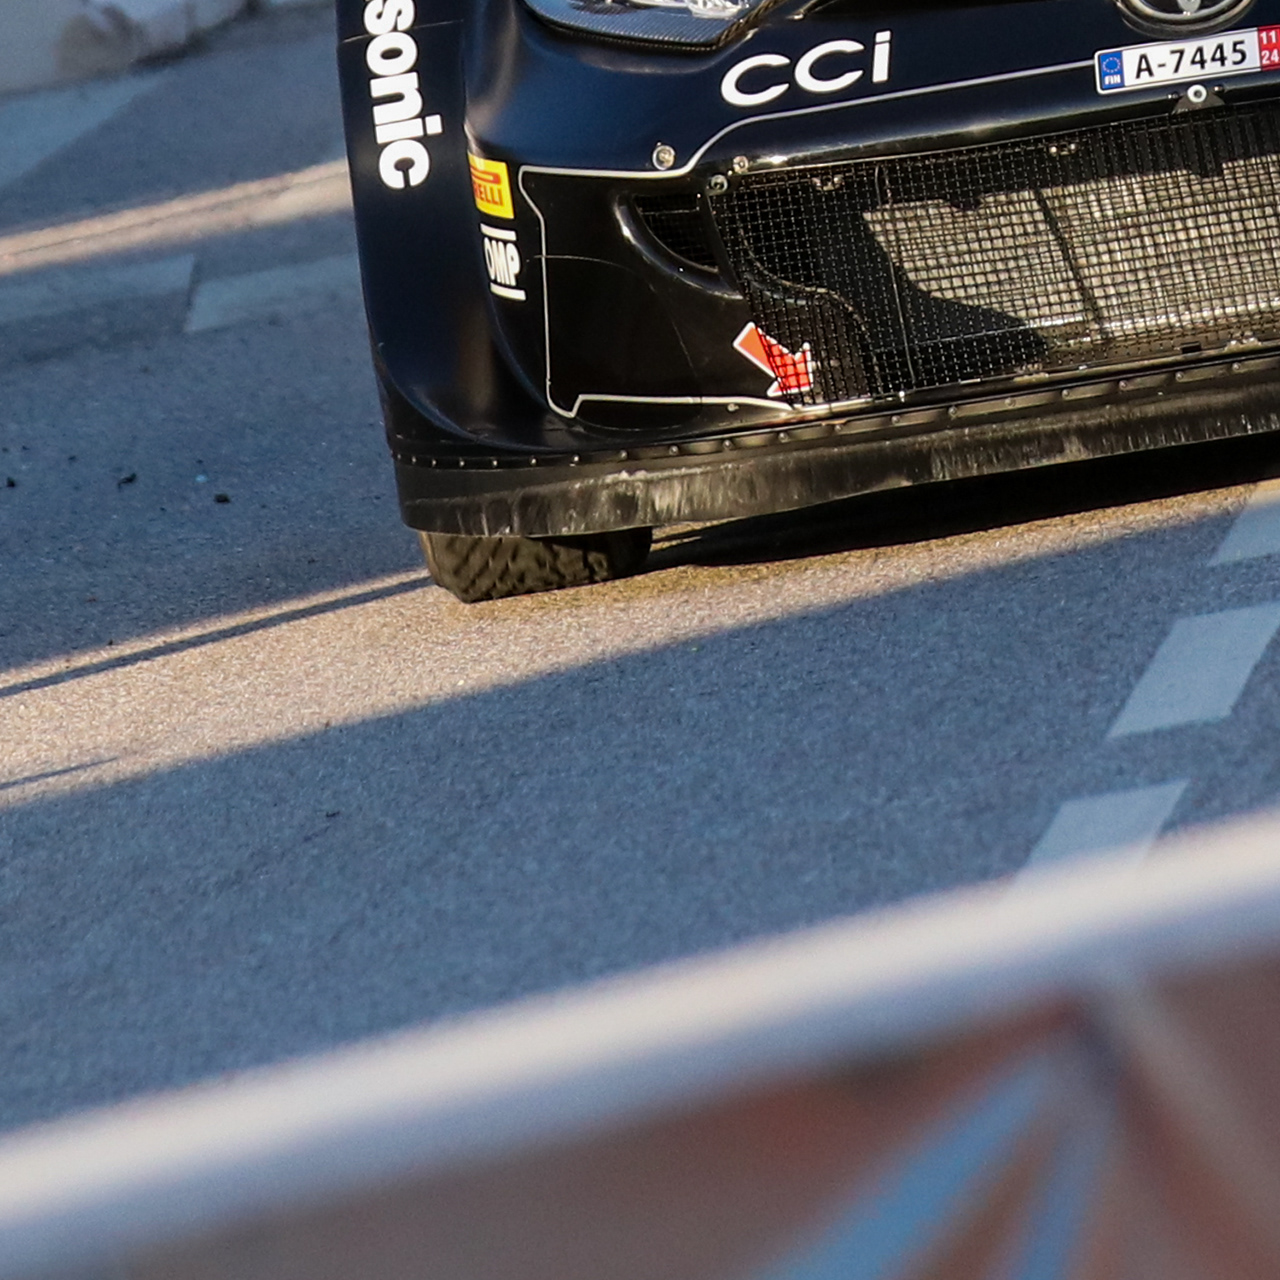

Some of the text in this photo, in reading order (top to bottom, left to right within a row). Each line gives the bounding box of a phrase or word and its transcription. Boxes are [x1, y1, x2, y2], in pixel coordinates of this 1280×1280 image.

[1259, 30, 1277, 45] 11
[1104, 40, 1247, 85] FIN A-7445
[1261, 49, 1280, 65] 24
[483, 236, 521, 287] OMP
